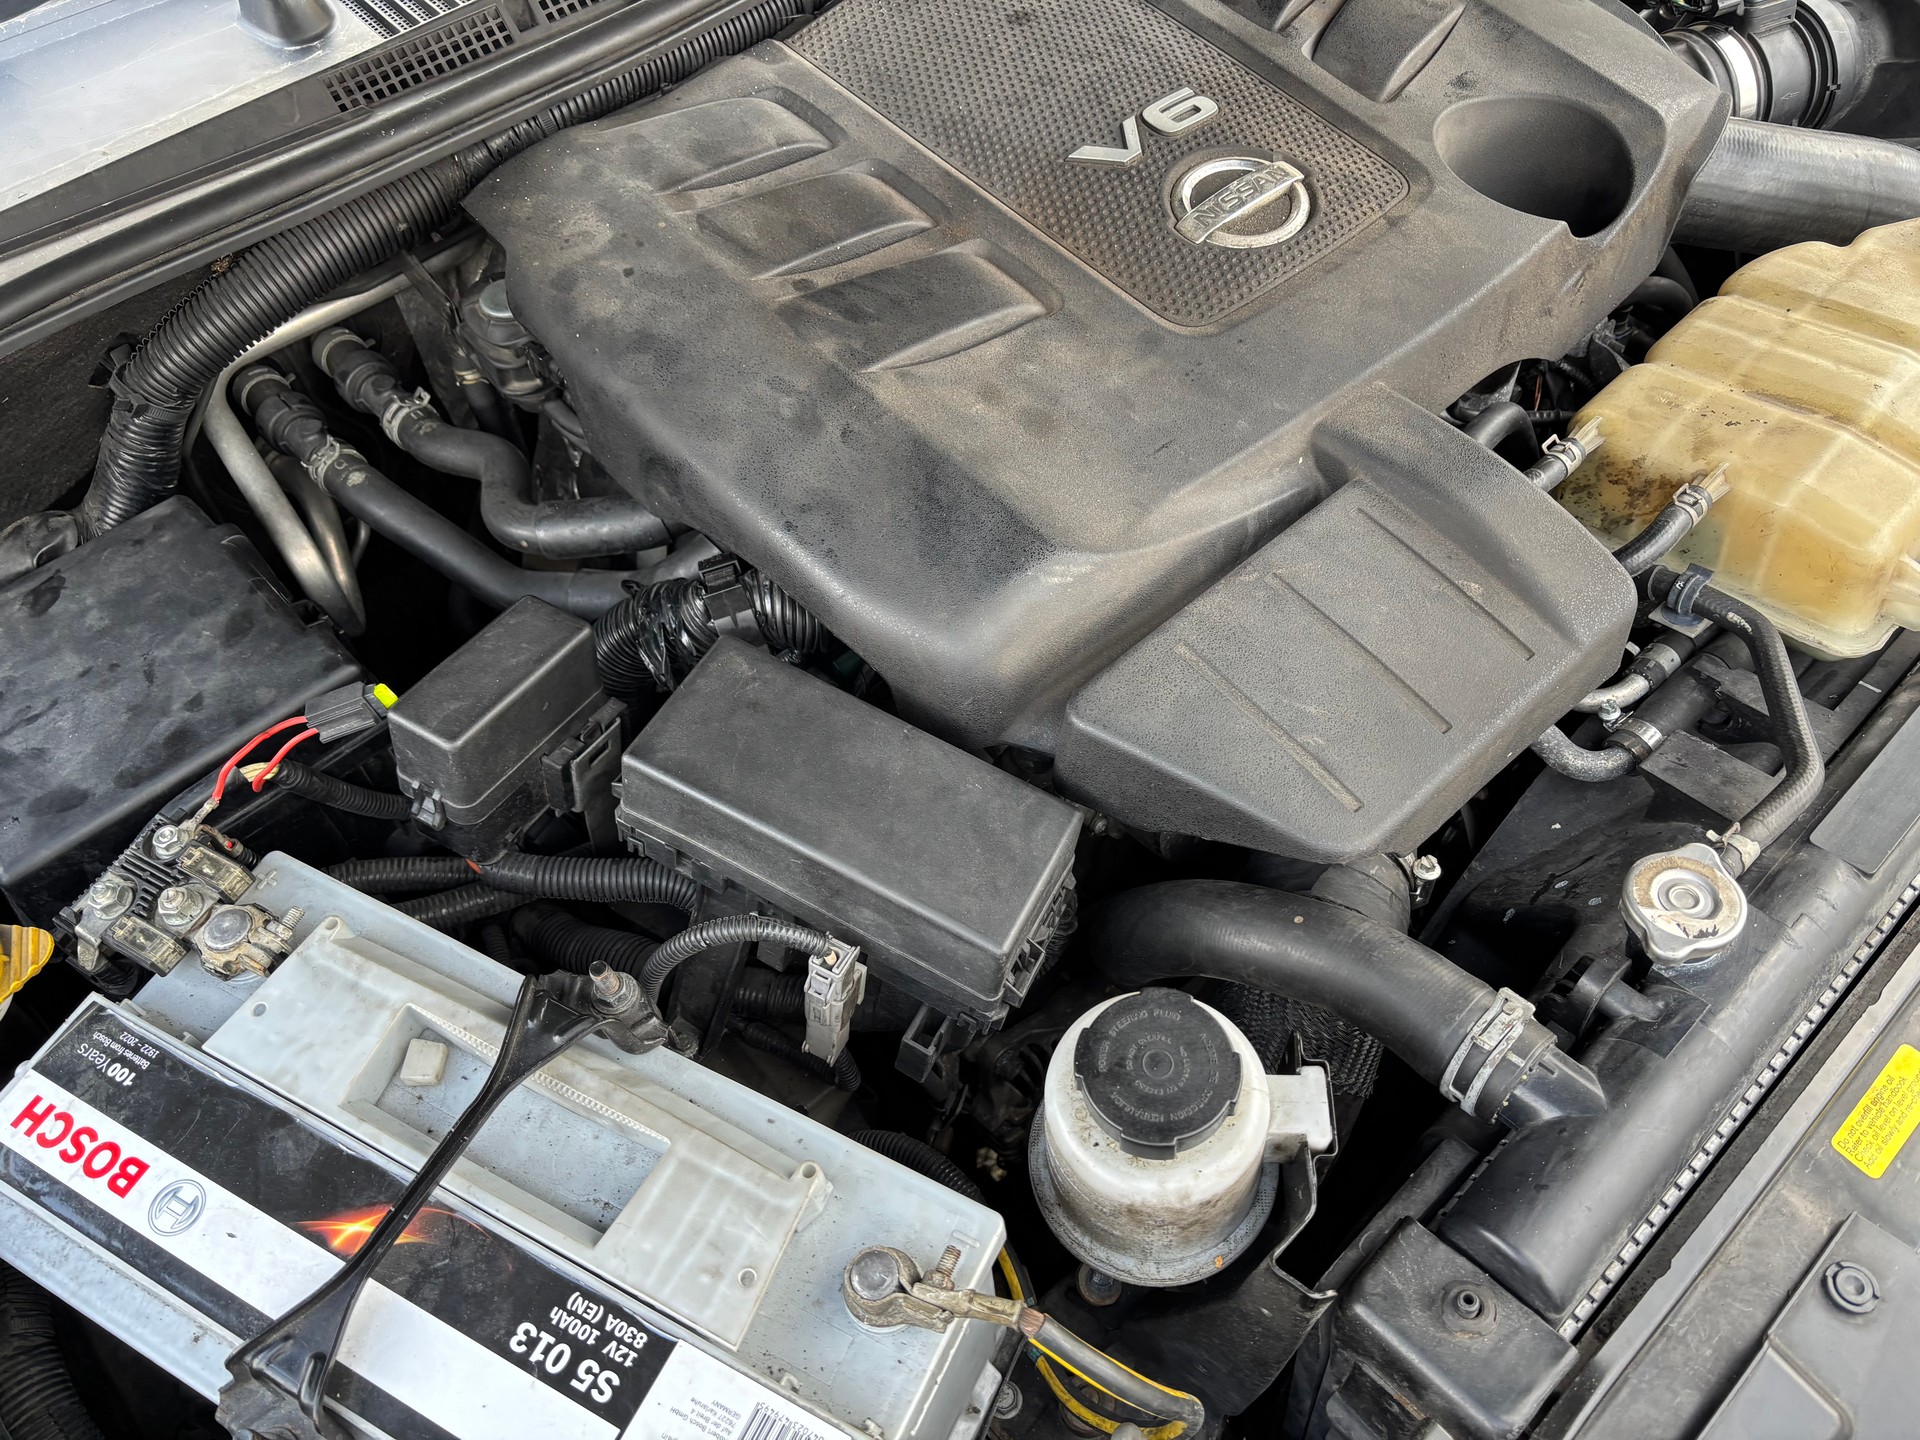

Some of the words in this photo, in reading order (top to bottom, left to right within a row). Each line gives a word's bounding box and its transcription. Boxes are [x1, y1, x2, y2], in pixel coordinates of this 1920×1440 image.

[1066, 87, 1220, 165] V6
[1191, 166, 1291, 231] NISSAN
[92, 1031, 112, 1047] Bosch
[109, 1041, 126, 1055] from
[119, 1031, 139, 1047] 2022
[140, 1043, 160, 1059] 1922
[77, 1043, 111, 1073] Years
[122, 1048, 151, 1070] Batteries
[106, 1062, 136, 1086] 100
[1837, 1138, 1850, 1150] Do
[1847, 1126, 1859, 1139] not
[1855, 1103, 1874, 1127] overfill
[1870, 1084, 1889, 1107] engine
[1886, 1074, 1896, 1086] oil
[1845, 1136, 1863, 1156] Refer
[1860, 1129, 1869, 1139] to
[1866, 1105, 1886, 1130] vehicle
[1882, 1076, 1908, 1107] handbook
[1854, 1139, 1874, 1162] Check
[1872, 1130, 1880, 1141] oil
[1876, 1115, 1891, 1132] level
[1889, 1106, 1899, 1117] on
[1896, 1091, 1909, 1108] level
[1906, 1068, 1920, 1093] groun
[10, 1094, 151, 1199] BOSCH
[1863, 1153, 1878, 1170] Add
[1875, 1143, 1884, 1155] oil
[1881, 1124, 1900, 1146] slowly
[1896, 1110, 1908, 1126] and
[566, 1291, 604, 1324] (EN)
[549, 1306, 601, 1346] 100Ah
[604, 1313, 648, 1349] 830A
[509, 1322, 572, 1375] 013
[601, 1340, 638, 1368] 12V
[568, 1359, 620, 1404] S5
[669, 1406, 689, 1421] GmbH
[690, 1397, 718, 1417] Karlsruhe
[711, 1399, 741, 1421] GERMANY
[689, 1417, 708, 1432] Bosch
